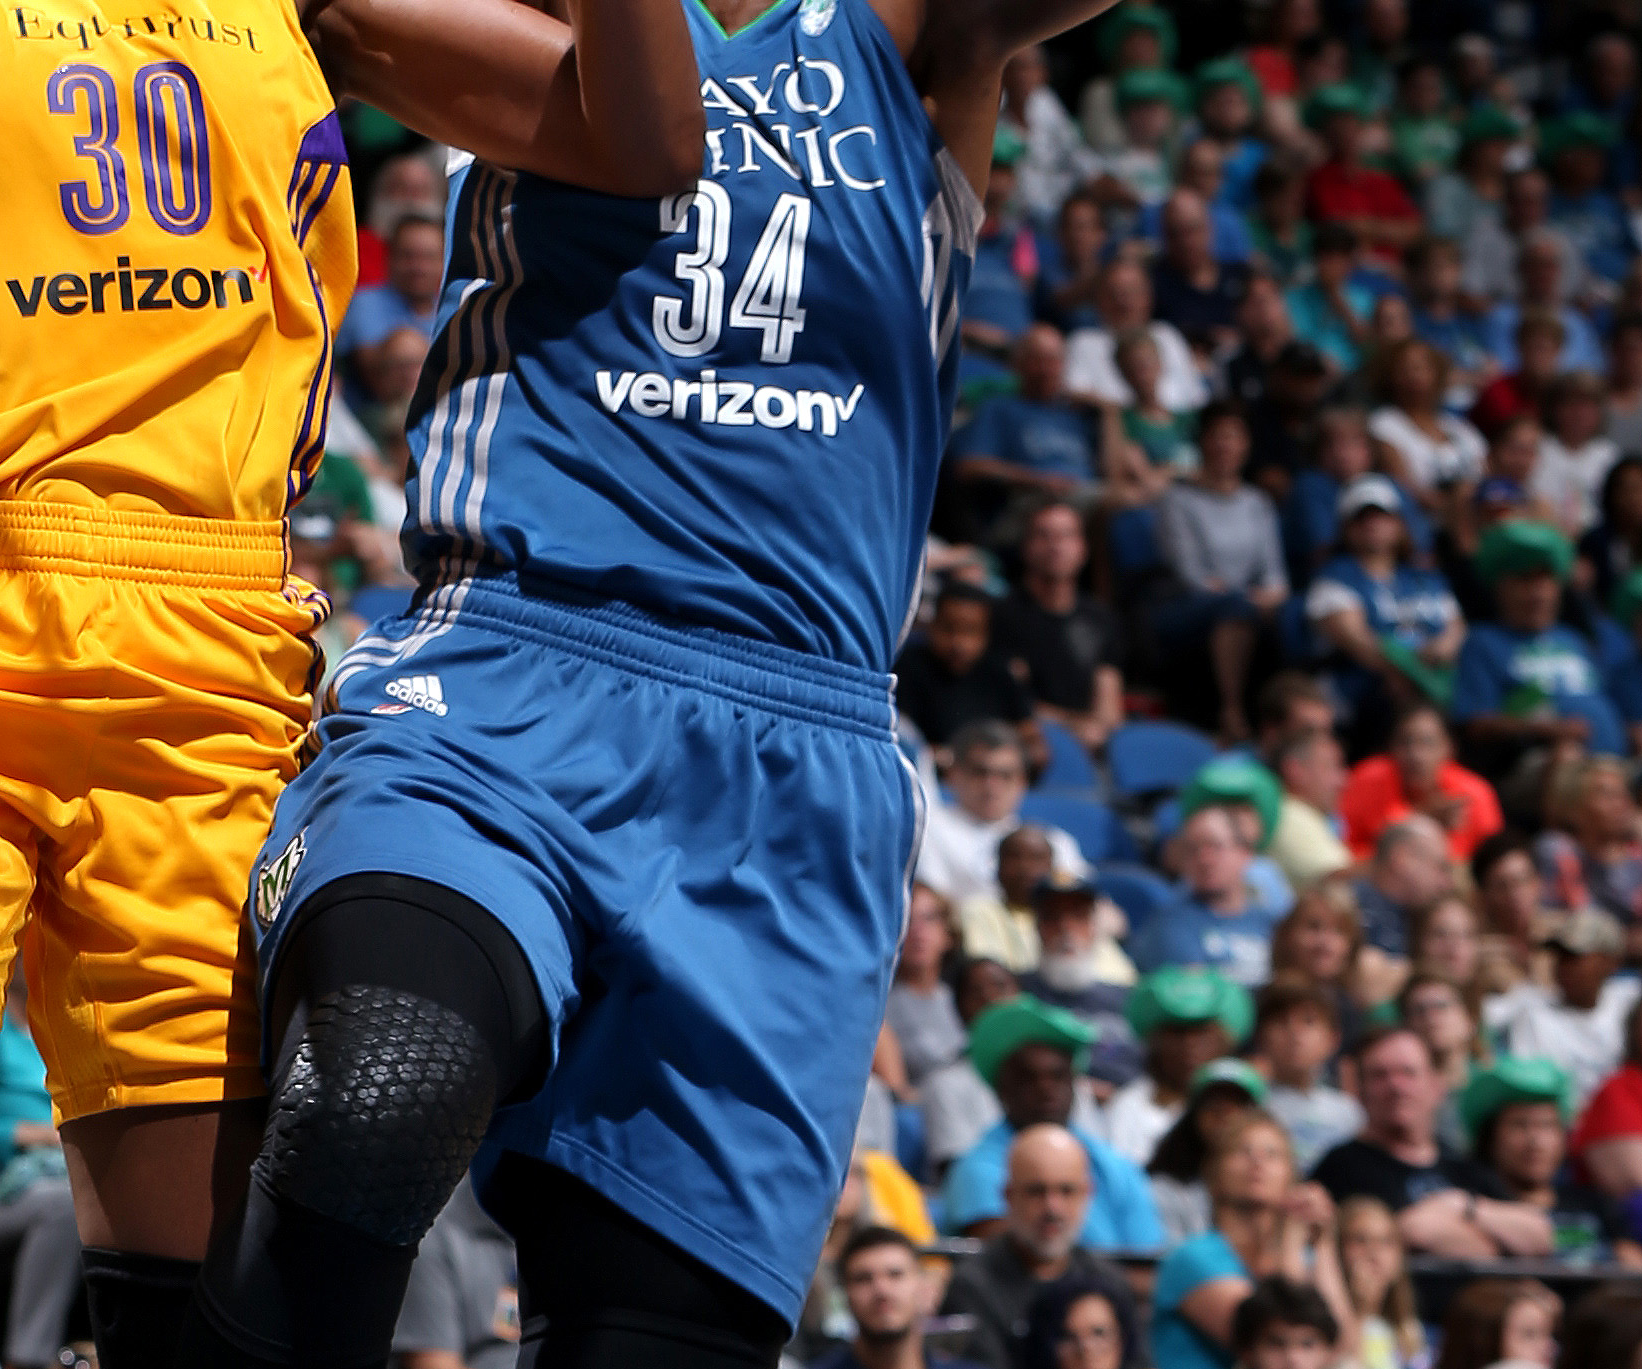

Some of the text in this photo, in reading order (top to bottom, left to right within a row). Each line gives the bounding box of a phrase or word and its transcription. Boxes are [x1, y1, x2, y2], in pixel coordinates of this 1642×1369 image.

[700, 55, 845, 118] AYO
[46, 60, 213, 237] 30
[5, 256, 255, 318] verizon
[652, 179, 812, 364] 34
[594, 368, 840, 438] verizon
[384, 681, 449, 717] adidas
